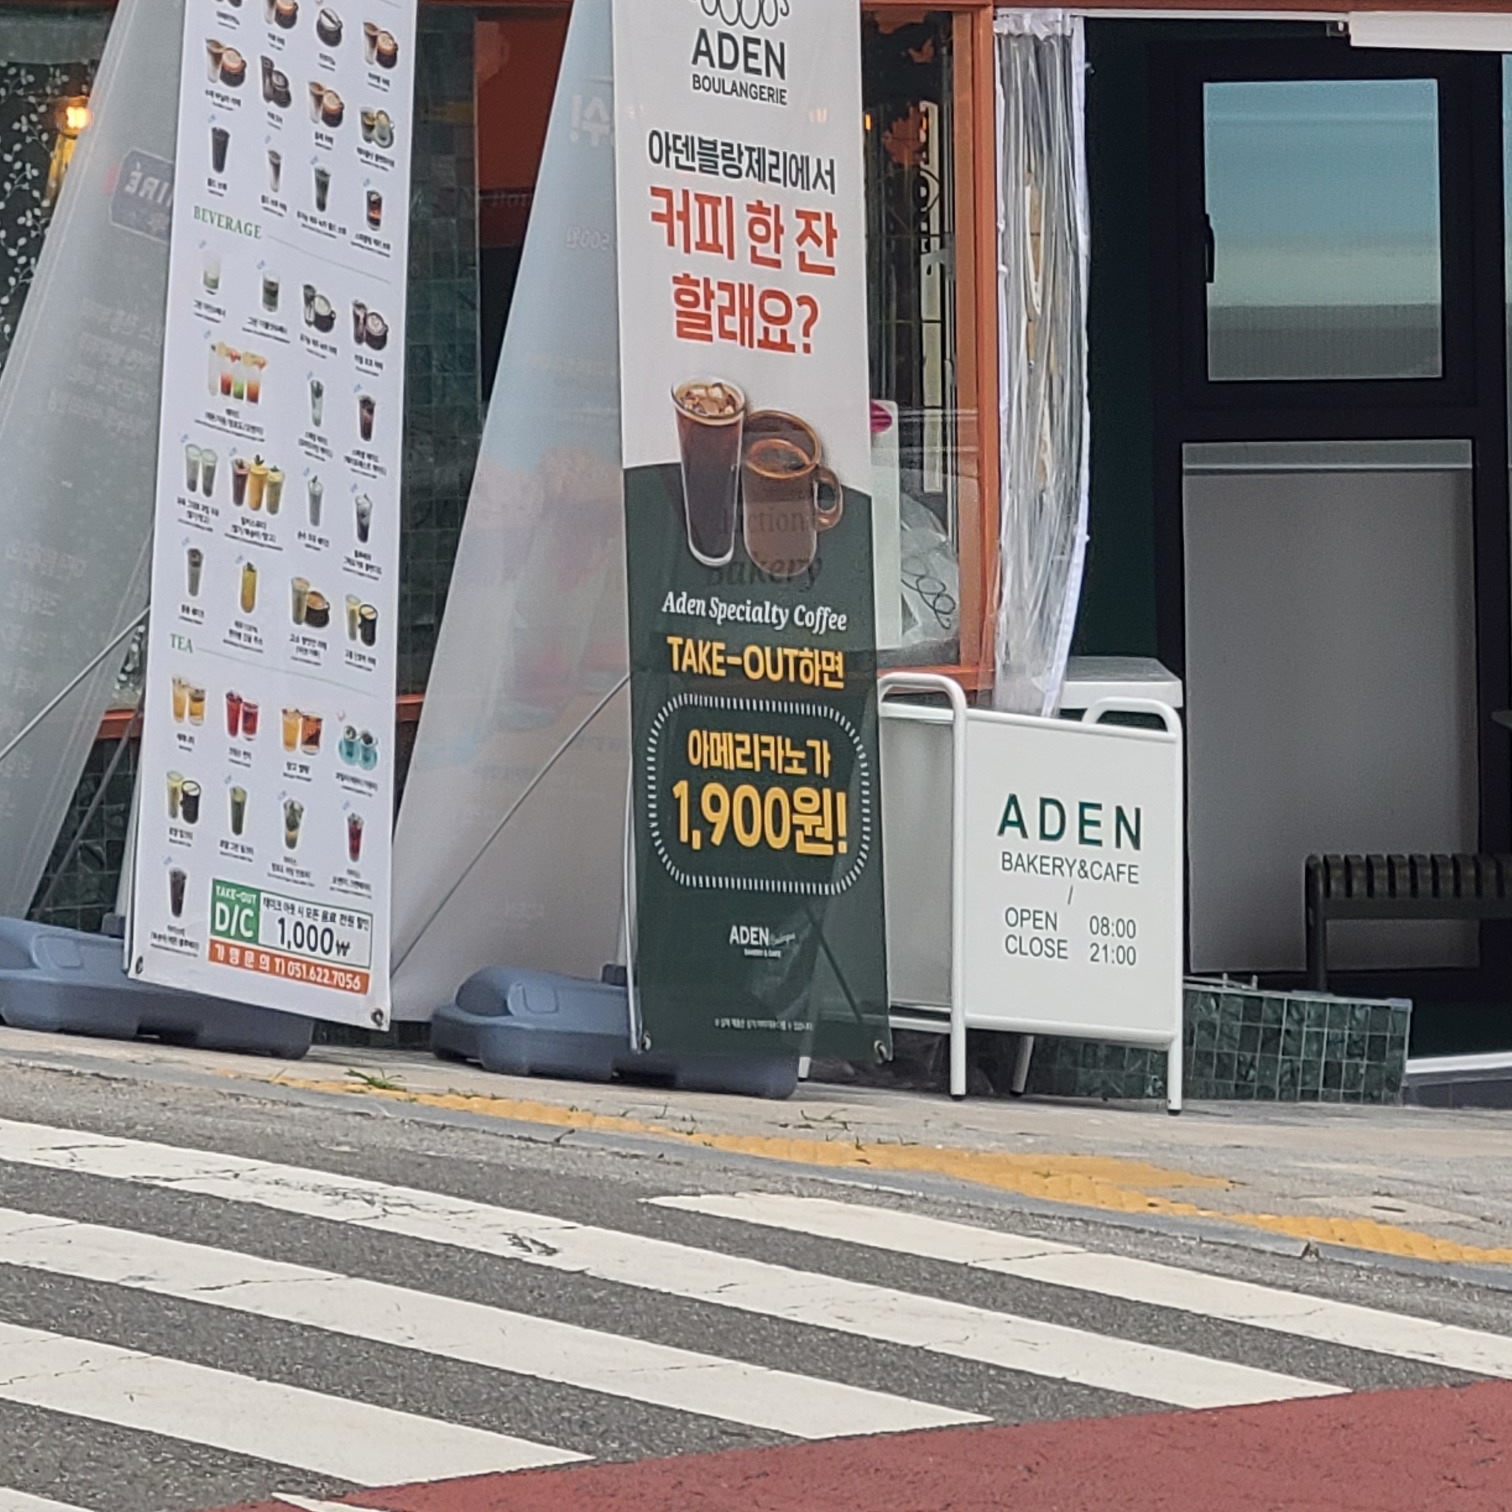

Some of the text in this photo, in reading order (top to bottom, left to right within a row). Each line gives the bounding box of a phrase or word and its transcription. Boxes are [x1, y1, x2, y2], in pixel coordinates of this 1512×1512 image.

[691, 27, 786, 81] ADEN
[692, 74, 788, 106] BOULANGERIE
[648, 129, 836, 195] 아덴블랑제리에서
[193, 204, 263, 240] BEVERAGE
[649, 186, 839, 276] 커피 한 잔
[672, 273, 819, 355] 할래요?
[661, 591, 848, 635] Aden Specialty Coffee
[169, 633, 194, 654] TEA
[666, 635, 845, 690] TAKE-OUT하면
[687, 729, 832, 778] 아메리카노가
[672, 779, 848, 856] 1,900원!
[997, 793, 1142, 851] ADEN
[1001, 851, 1140, 885] BAKERY&CAFE
[214, 901, 255, 938] D/C
[729, 925, 770, 946] ADEN
[1005, 907, 1137, 938] OPEN 08:00
[1005, 934, 1137, 966] CLOSE 21:00
